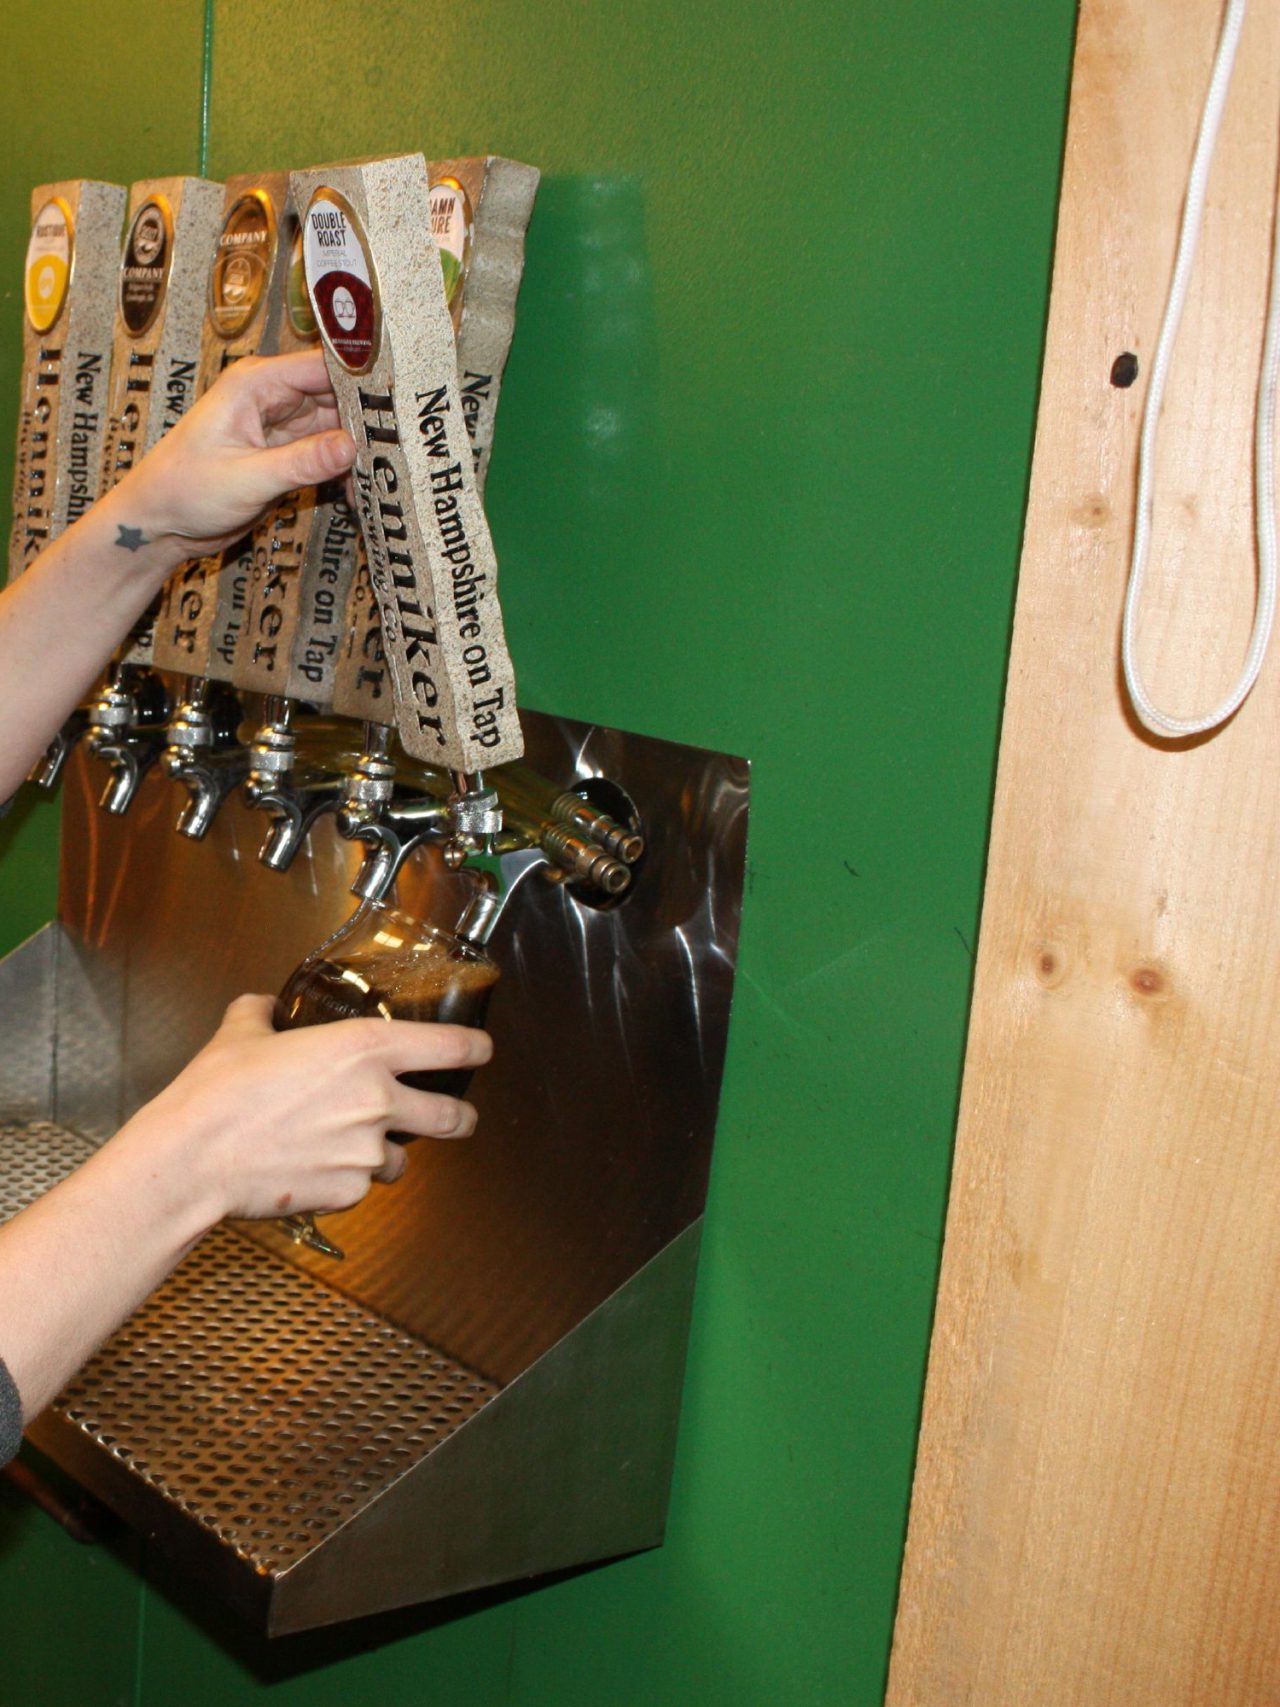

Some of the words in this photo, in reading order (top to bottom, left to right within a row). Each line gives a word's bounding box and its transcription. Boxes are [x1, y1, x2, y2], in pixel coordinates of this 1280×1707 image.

[311, 211, 347, 230] DOUBLE
[430, 197, 456, 215] AMN
[431, 216, 452, 234] URE
[220, 230, 268, 247] COMPANY
[317, 229, 347, 247] ROAST
[76, 352, 102, 405] New
[166, 358, 196, 416] New
[456, 370, 492, 440] New
[415, 385, 451, 459] New
[23, 349, 61, 556] Hennik
[66, 412, 99, 525] Hampshi
[354, 471, 389, 594] Brewing
[430, 461, 486, 640] Hampshire
[253, 491, 303, 672] niker
[358, 386, 446, 747] Henniker
[314, 589, 336, 625] on
[298, 634, 339, 683] Tap
[462, 645, 493, 689] on
[470, 687, 504, 748] Tap
